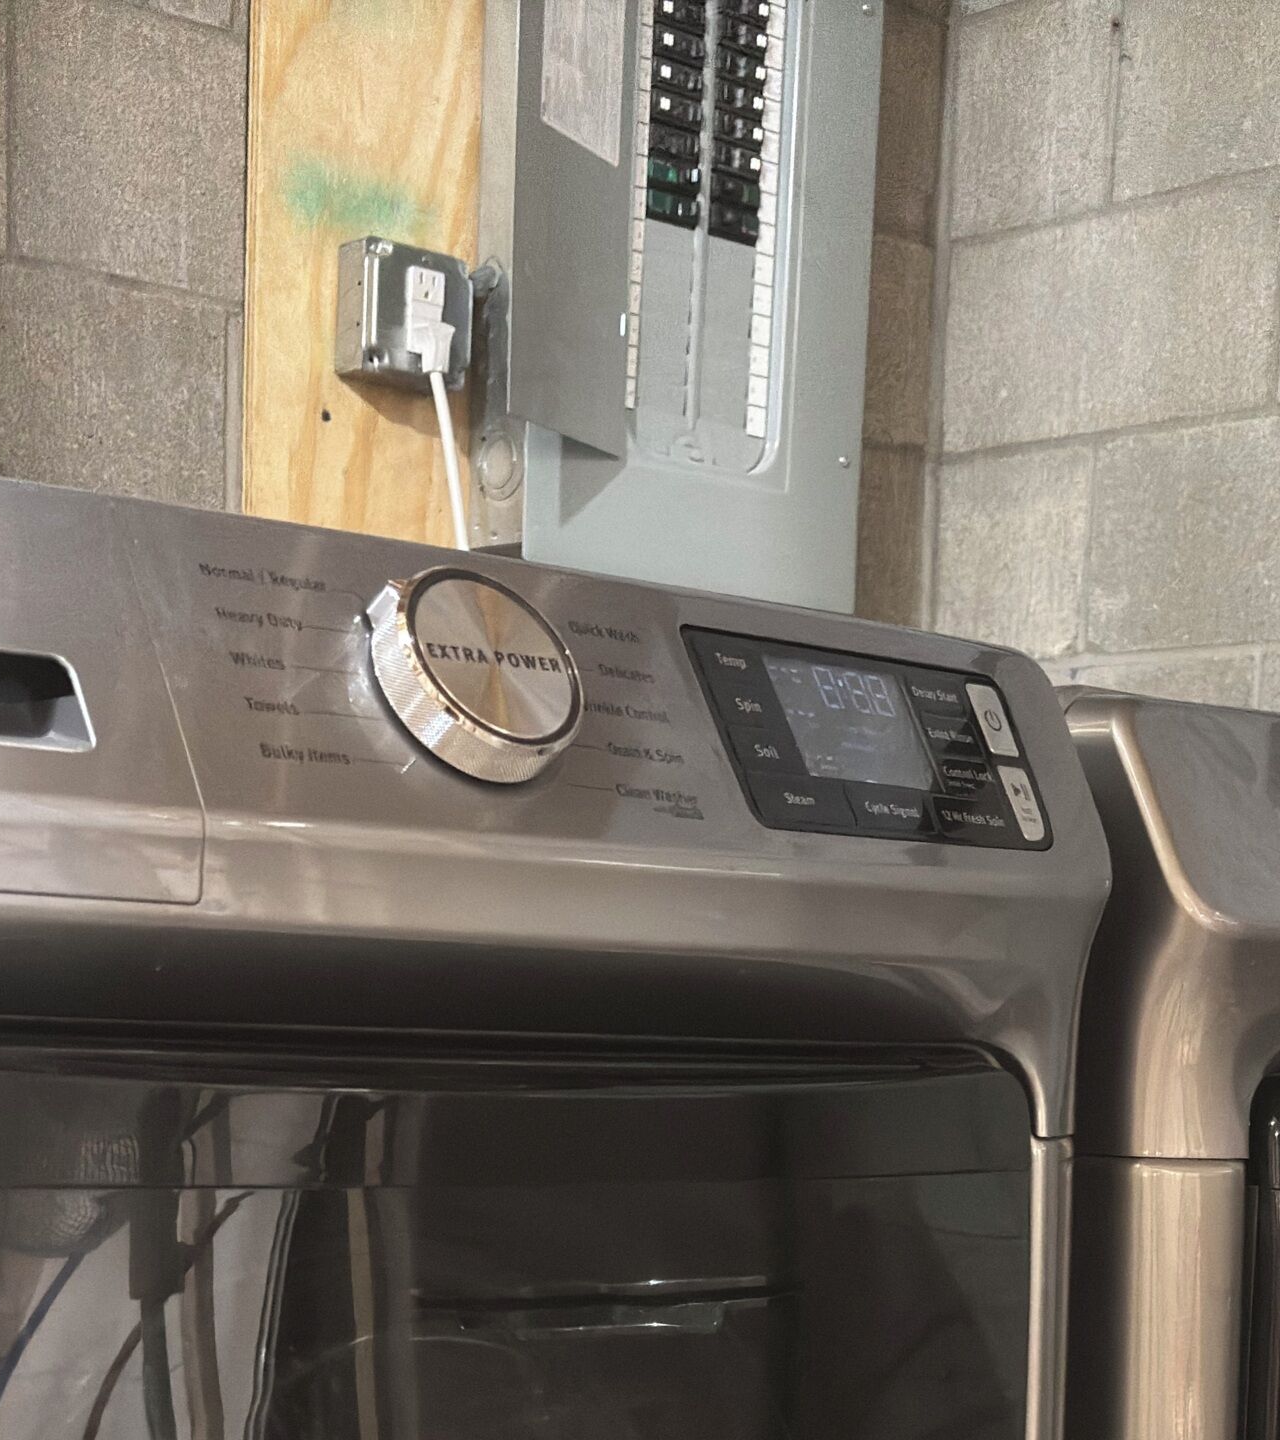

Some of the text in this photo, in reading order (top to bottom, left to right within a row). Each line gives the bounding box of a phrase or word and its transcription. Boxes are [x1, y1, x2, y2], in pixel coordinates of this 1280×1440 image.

[198, 563, 254, 582] Normal
[228, 651, 286, 671] Whites
[425, 642, 562, 674] EXTRA POWER
[714, 652, 747, 670] Temp
[244, 696, 300, 716] Towels
[735, 697, 763, 714] Spin
[259, 742, 351, 765] Bulky Items
[754, 744, 781, 761] Soil
[783, 791, 816, 806] Steam
